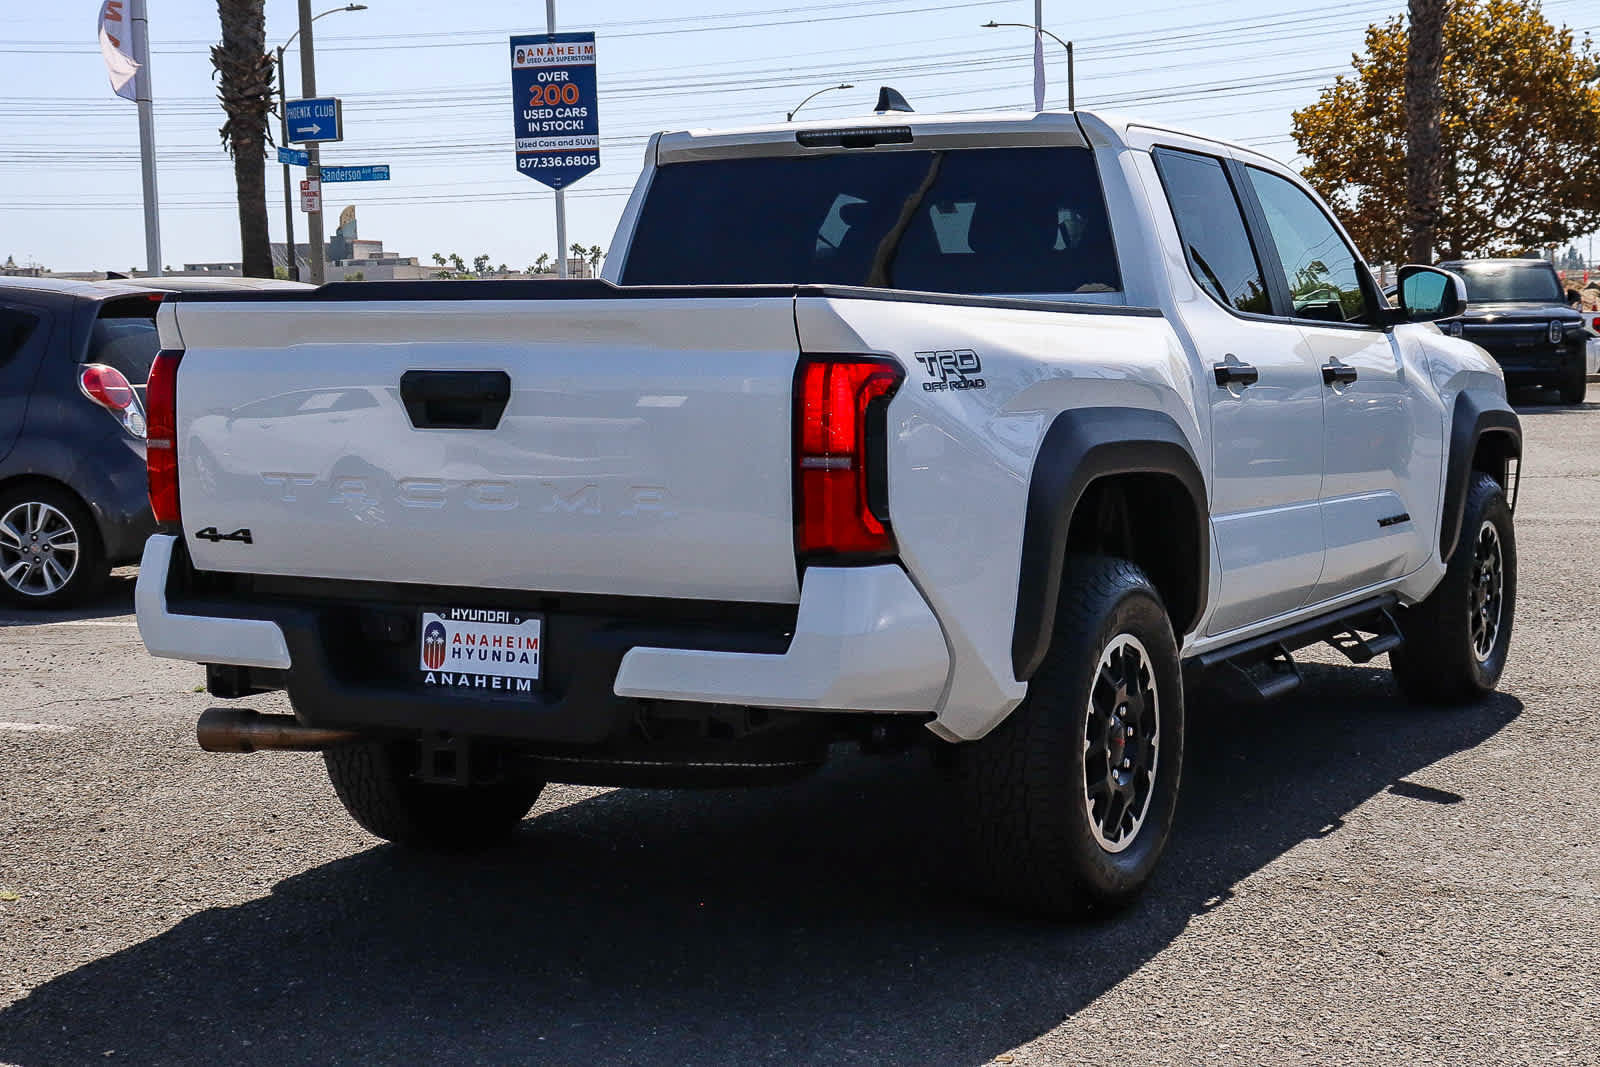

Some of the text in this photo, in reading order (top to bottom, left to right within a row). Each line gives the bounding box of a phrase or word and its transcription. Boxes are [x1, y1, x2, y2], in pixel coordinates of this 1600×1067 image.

[527, 46, 594, 57] ANAHEIM
[526, 56, 542, 64] USED
[556, 54, 593, 63] SUPERSTORE
[537, 71, 569, 82] OVER
[529, 83, 579, 106] 200
[287, 104, 334, 120] PHOENIX CLUB
[523, 107, 588, 119] USED CARS
[528, 120, 584, 132] IN STOCK!
[518, 137, 596, 148] Used Cars and SUVs
[519, 155, 597, 168] 877.336.6805
[321, 168, 362, 181] Sanderson
[914, 349, 981, 382] TRD
[922, 379, 986, 391] OFF ROAD
[260, 471, 678, 518] TACOMA
[451, 608, 510, 623] HYUNDAI
[452, 633, 538, 650] ANAHEIM
[451, 647, 538, 665] HYUNDAI
[424, 672, 531, 691] ANAHEIM
